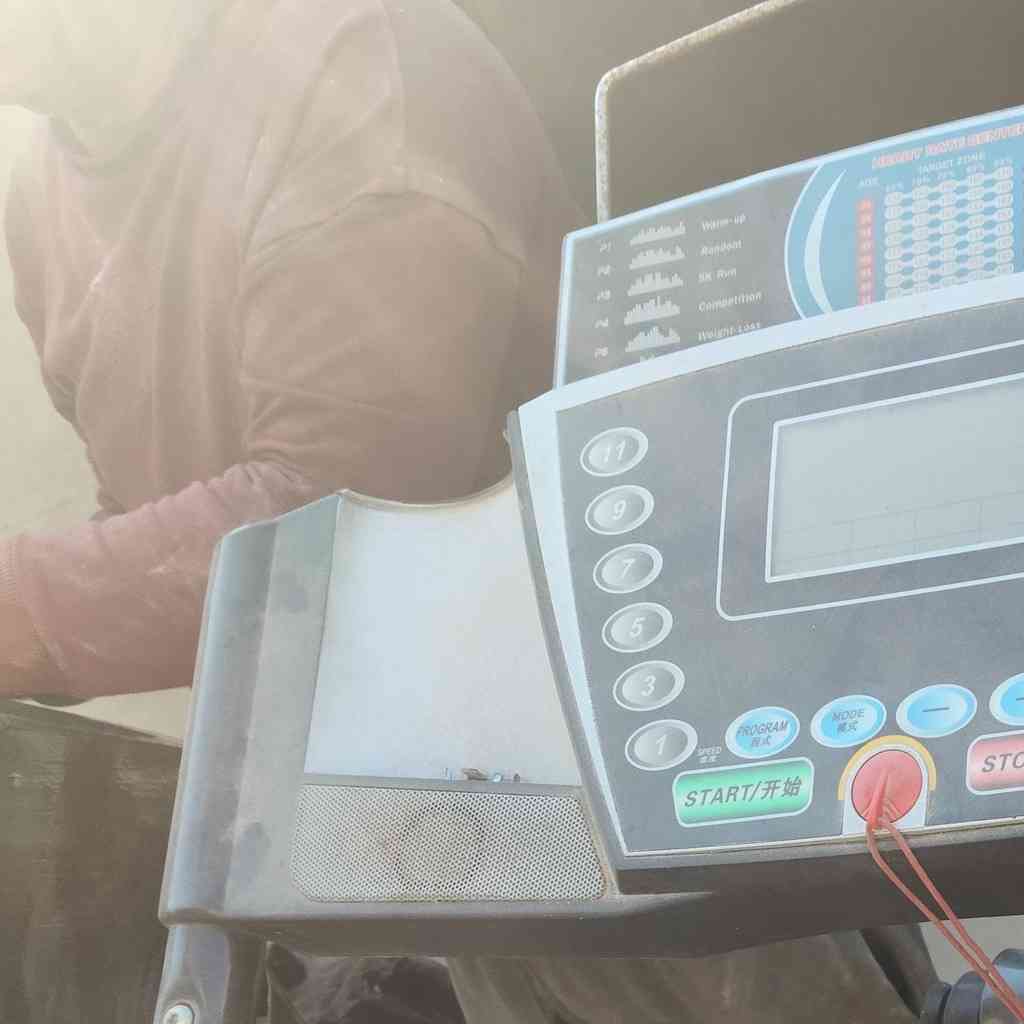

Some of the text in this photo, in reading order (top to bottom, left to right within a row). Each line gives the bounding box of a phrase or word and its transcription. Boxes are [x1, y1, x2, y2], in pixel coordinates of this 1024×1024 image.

[602, 440, 626, 464] 11
[612, 499, 626, 521] 9
[621, 558, 637, 579] 7
[628, 616, 646, 639] 5
[640, 674, 657, 697] 3
[832, 707, 865, 722] MODE
[737, 718, 790, 738] PROGRAM
[655, 733, 668, 756] 1
